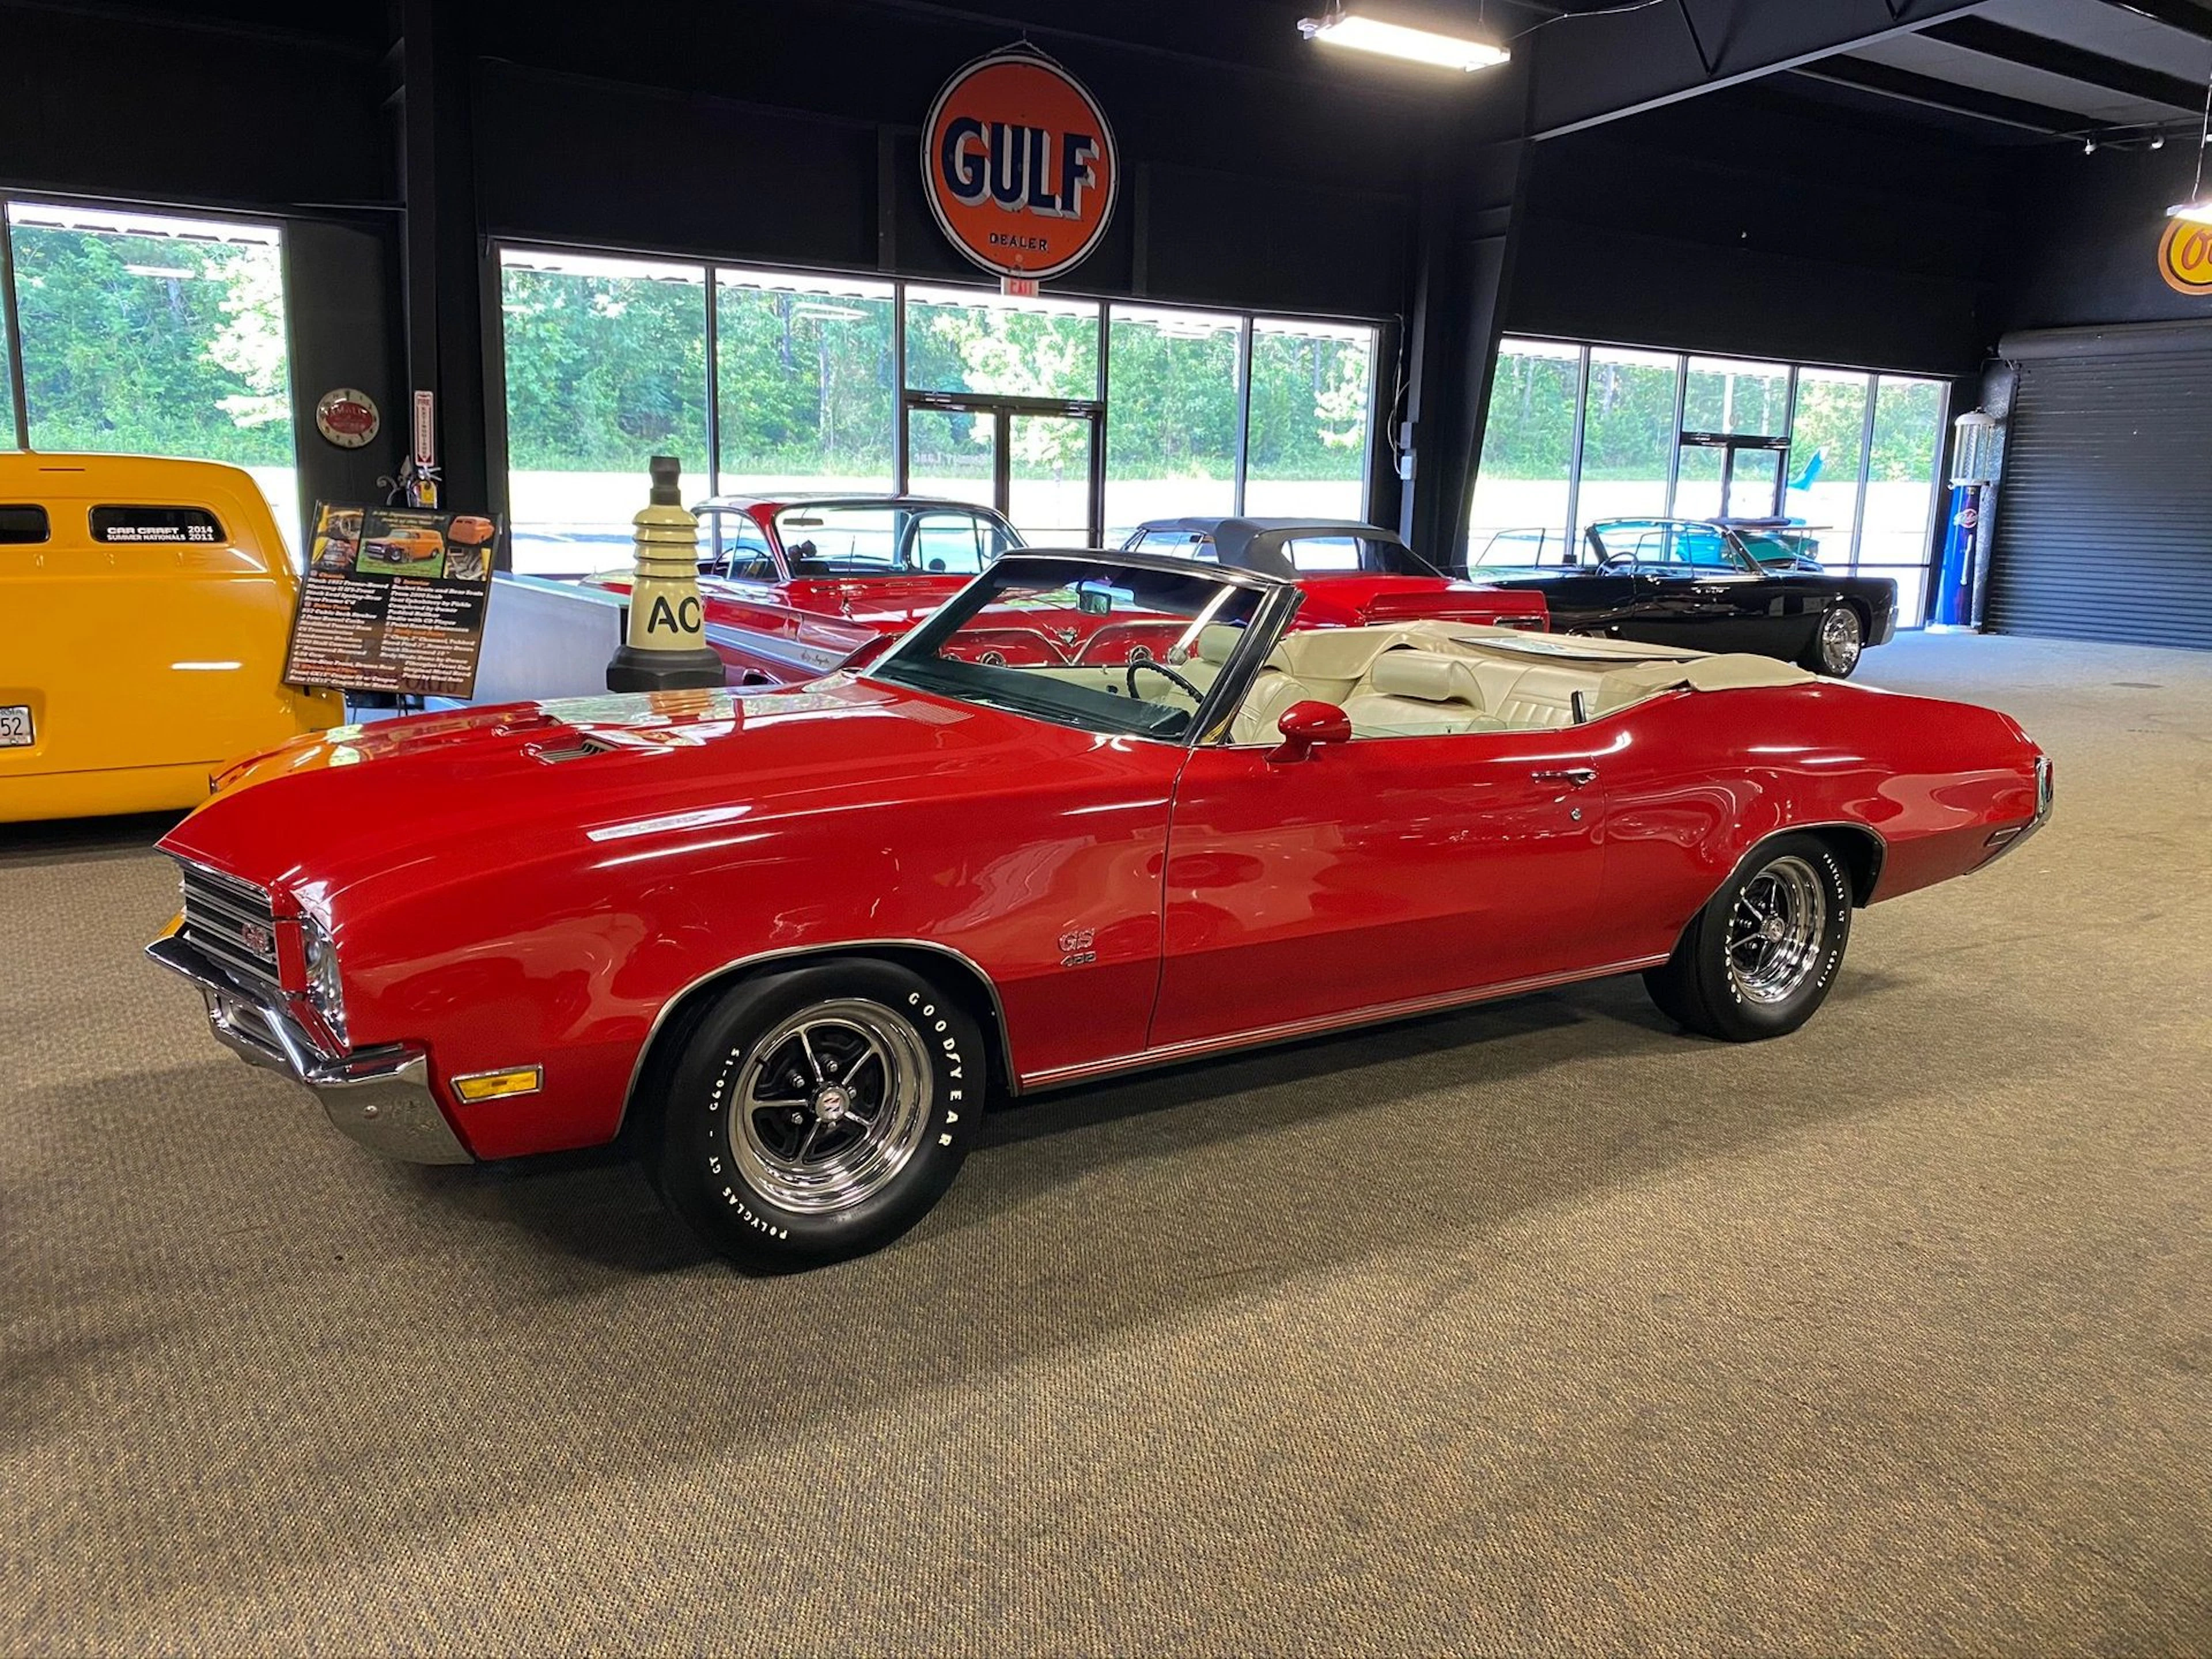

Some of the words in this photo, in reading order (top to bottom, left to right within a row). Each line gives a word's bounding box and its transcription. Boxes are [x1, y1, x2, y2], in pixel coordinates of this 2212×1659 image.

[941, 116, 1100, 221] GULF
[990, 233, 1048, 251] DEALER
[107, 527, 135, 535] CAR
[137, 527, 180, 535] CRAFT
[187, 525, 214, 533] 2014
[647, 596, 701, 634] AC
[1823, 853, 1844, 900] POLYGLAS
[1059, 928, 1095, 951] GS
[908, 991, 963, 1147] GOODYEAR
[709, 1155, 721, 1175] GT
[722, 1186, 788, 1240] POLYGLAS
